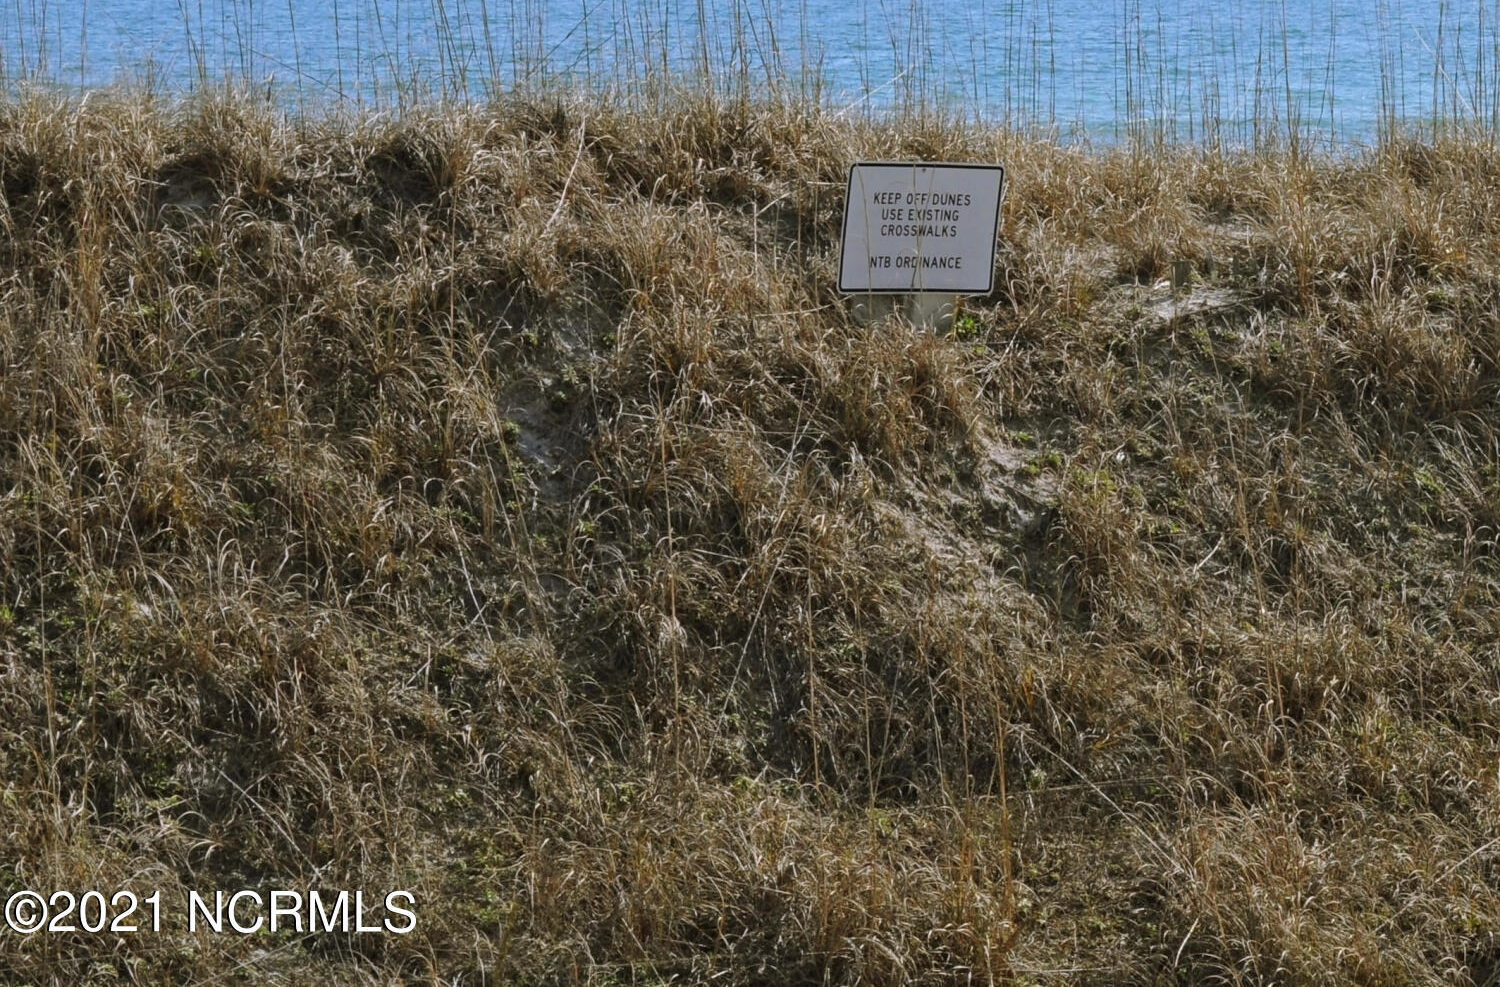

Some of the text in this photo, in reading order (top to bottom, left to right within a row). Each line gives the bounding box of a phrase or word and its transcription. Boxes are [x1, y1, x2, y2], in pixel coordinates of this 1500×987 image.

[873, 192, 971, 206] KEEP OFF DUNES
[881, 208, 959, 221] USE EXISTING
[881, 224, 957, 237] CROSSWALKS
[870, 256, 891, 269] NTB
